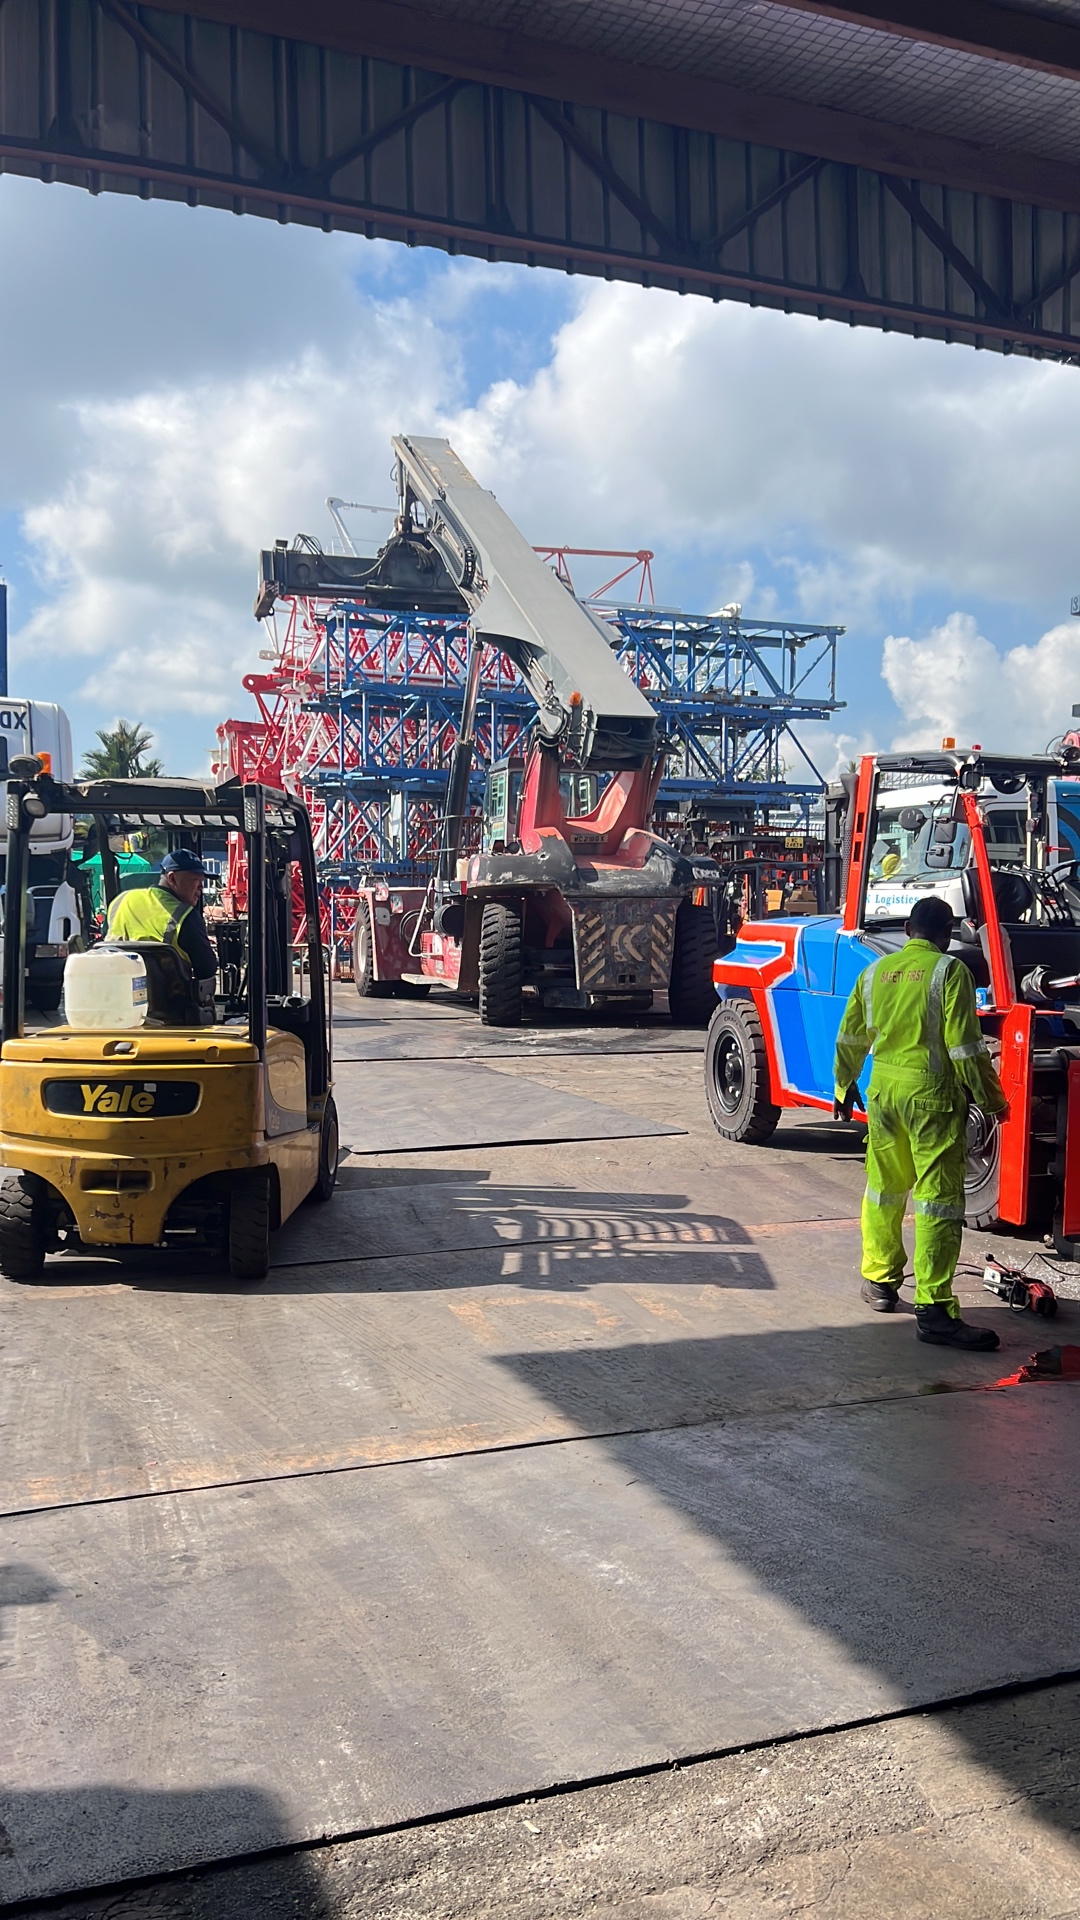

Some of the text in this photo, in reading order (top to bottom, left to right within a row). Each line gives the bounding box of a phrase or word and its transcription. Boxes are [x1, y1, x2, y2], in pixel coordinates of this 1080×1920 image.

[875, 894, 919, 906] Logistics
[881, 969, 925, 983] SAFETY FIRST
[81, 1084, 155, 1113] Yale
